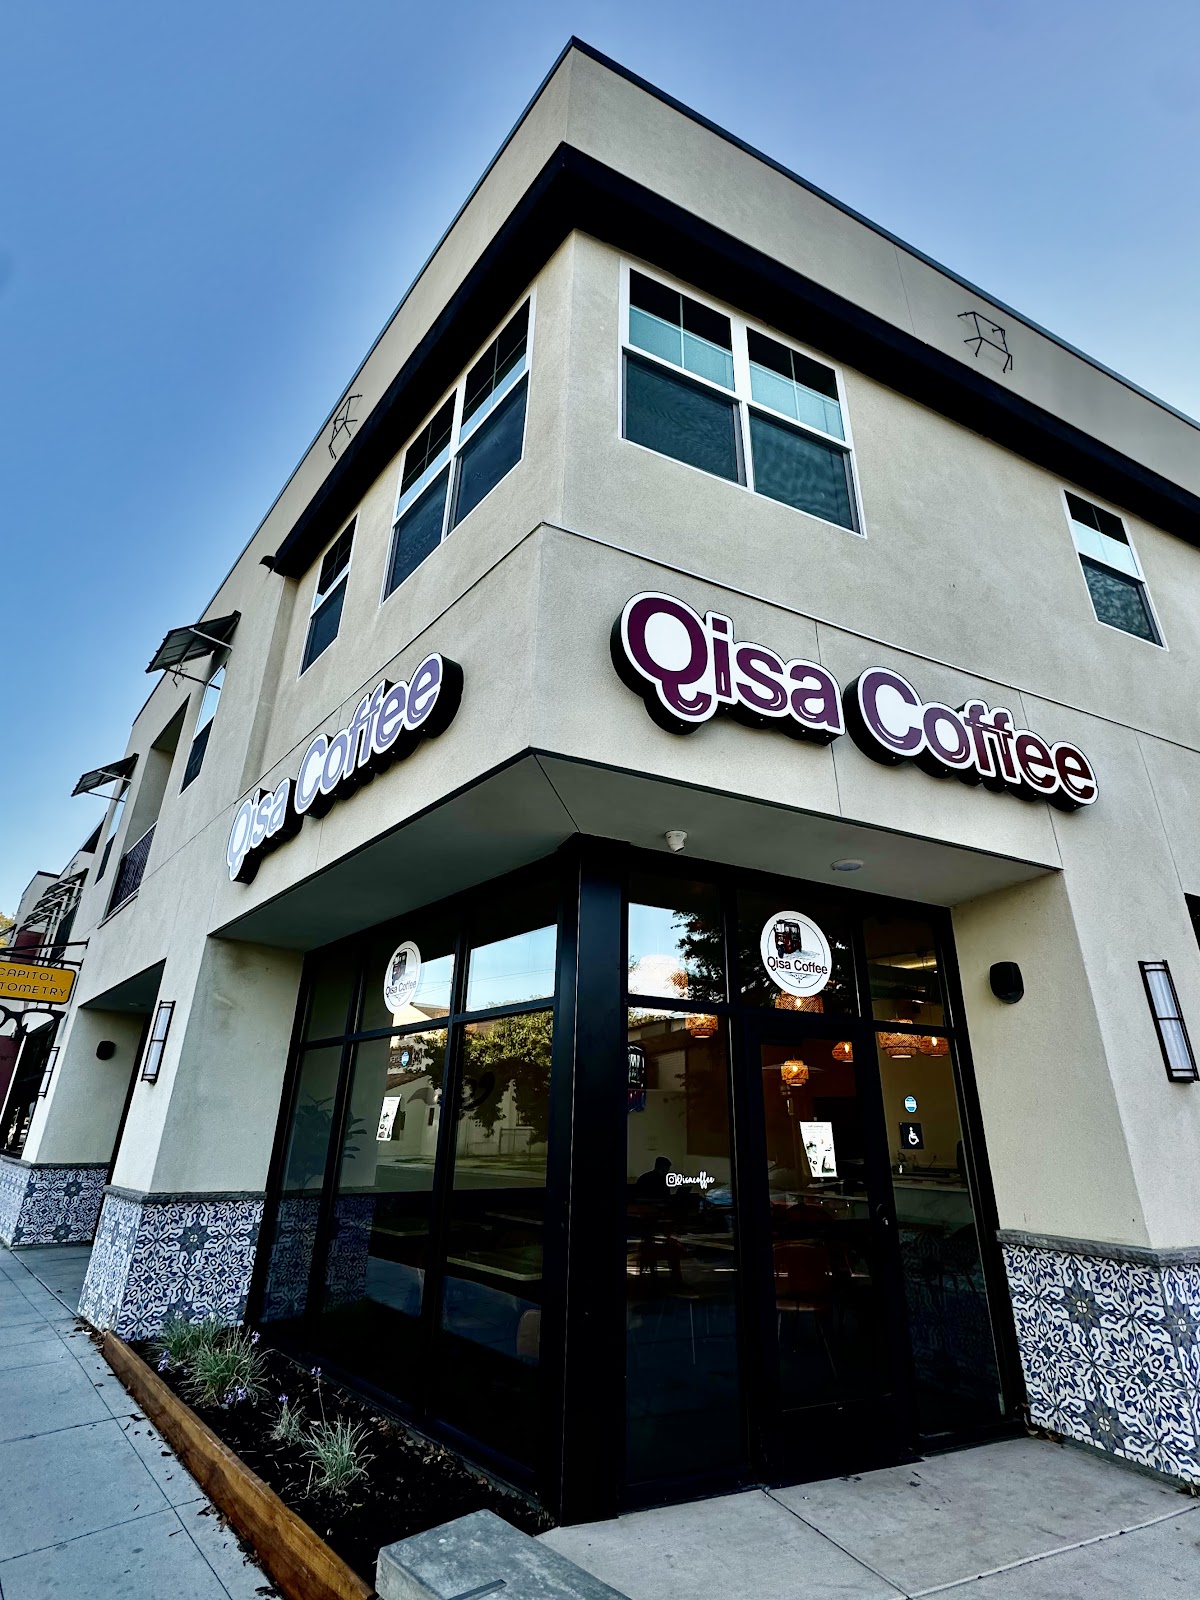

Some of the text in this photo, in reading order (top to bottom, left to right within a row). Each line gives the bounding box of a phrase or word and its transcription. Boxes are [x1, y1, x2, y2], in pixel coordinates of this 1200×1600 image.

[627, 597, 1096, 800] Qisa Coffee
[228, 658, 440, 877] Qisa Coffee
[0, 967, 56, 982] CAPITOL
[767, 956, 827, 974] Qisa Coffee
